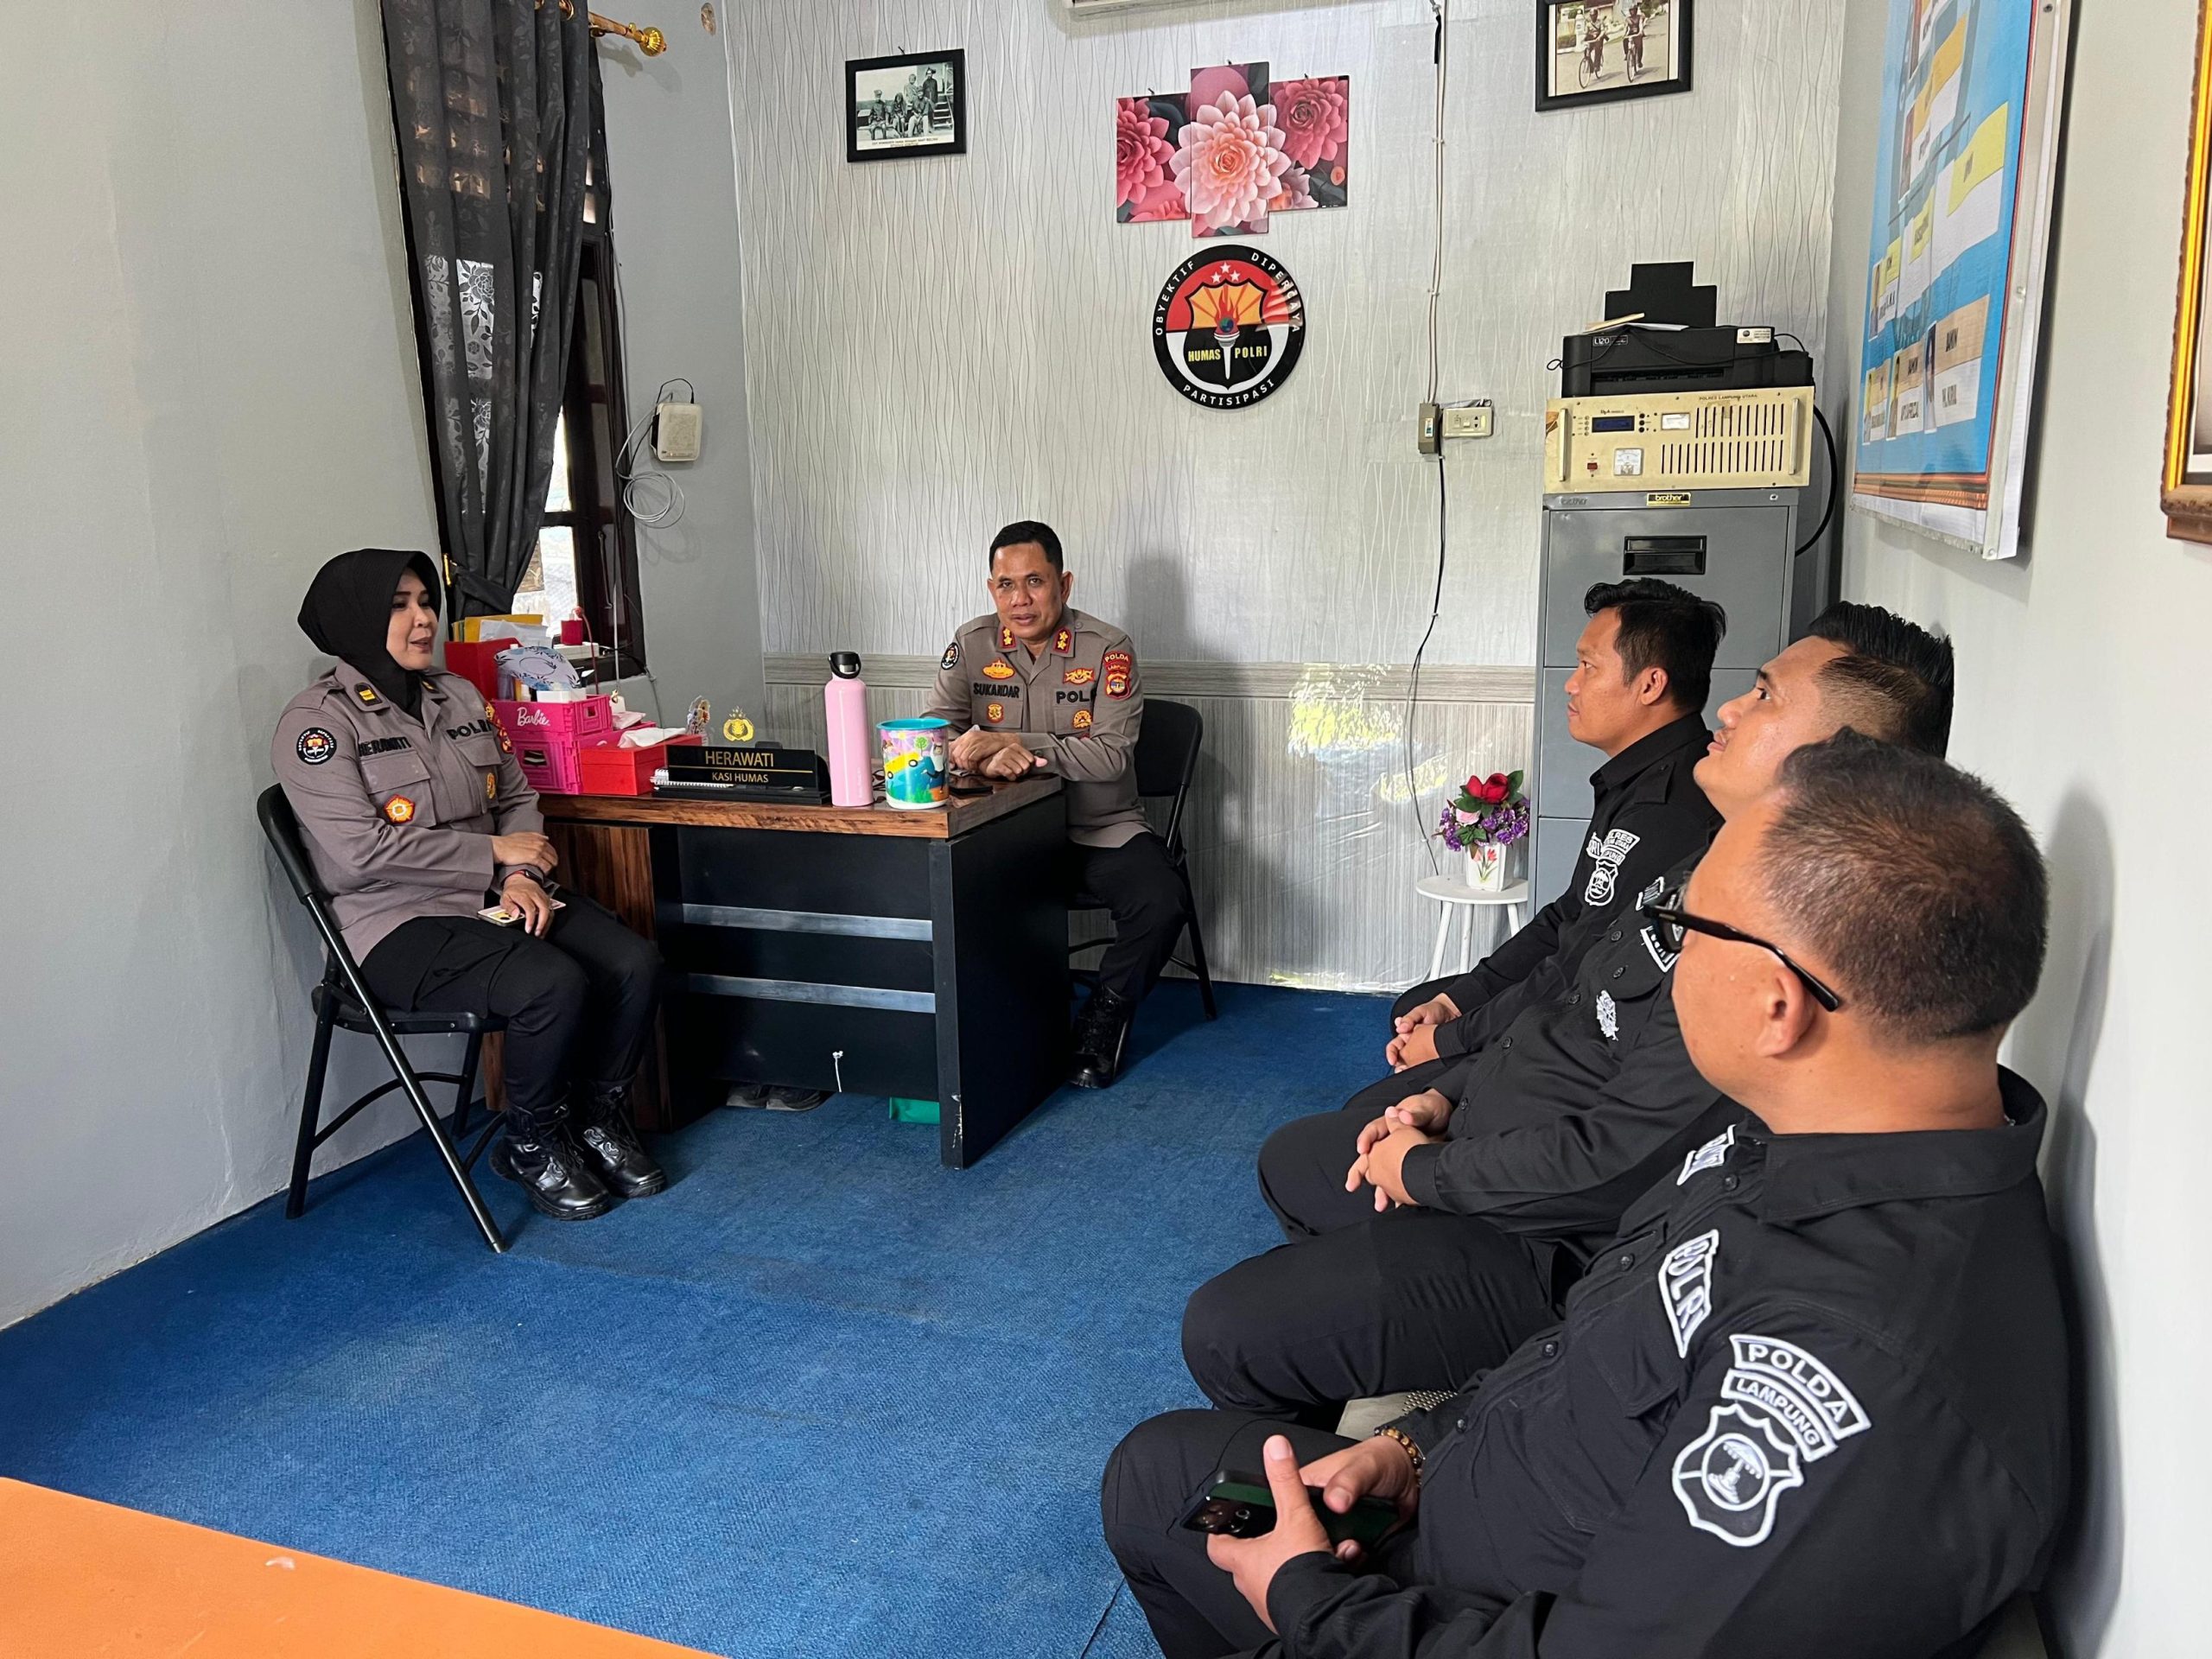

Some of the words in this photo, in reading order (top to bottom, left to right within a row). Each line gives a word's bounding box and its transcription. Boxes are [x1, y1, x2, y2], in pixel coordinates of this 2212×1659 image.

[1155, 260, 1195, 336] OBYEKTIF
[1251, 251, 1300, 333] DIPERCAYA
[1187, 348, 1221, 362] HUMAS
[1235, 346, 1268, 359] POLRI
[1183, 378, 1274, 406] PARTISIPASI
[1656, 493, 1682, 502] brother
[1104, 653, 1129, 663] POLDA
[973, 683, 1020, 699] SUKANDAR
[1056, 690, 1094, 704] POL
[517, 706, 550, 727] Barbie
[705, 750, 774, 767] HERAWATI
[712, 772, 733, 782] KASI
[734, 773, 769, 784] HUMAS
[1748, 1343, 1849, 1423] POLDA
[1736, 1377, 1821, 1446] LAMPUNG
